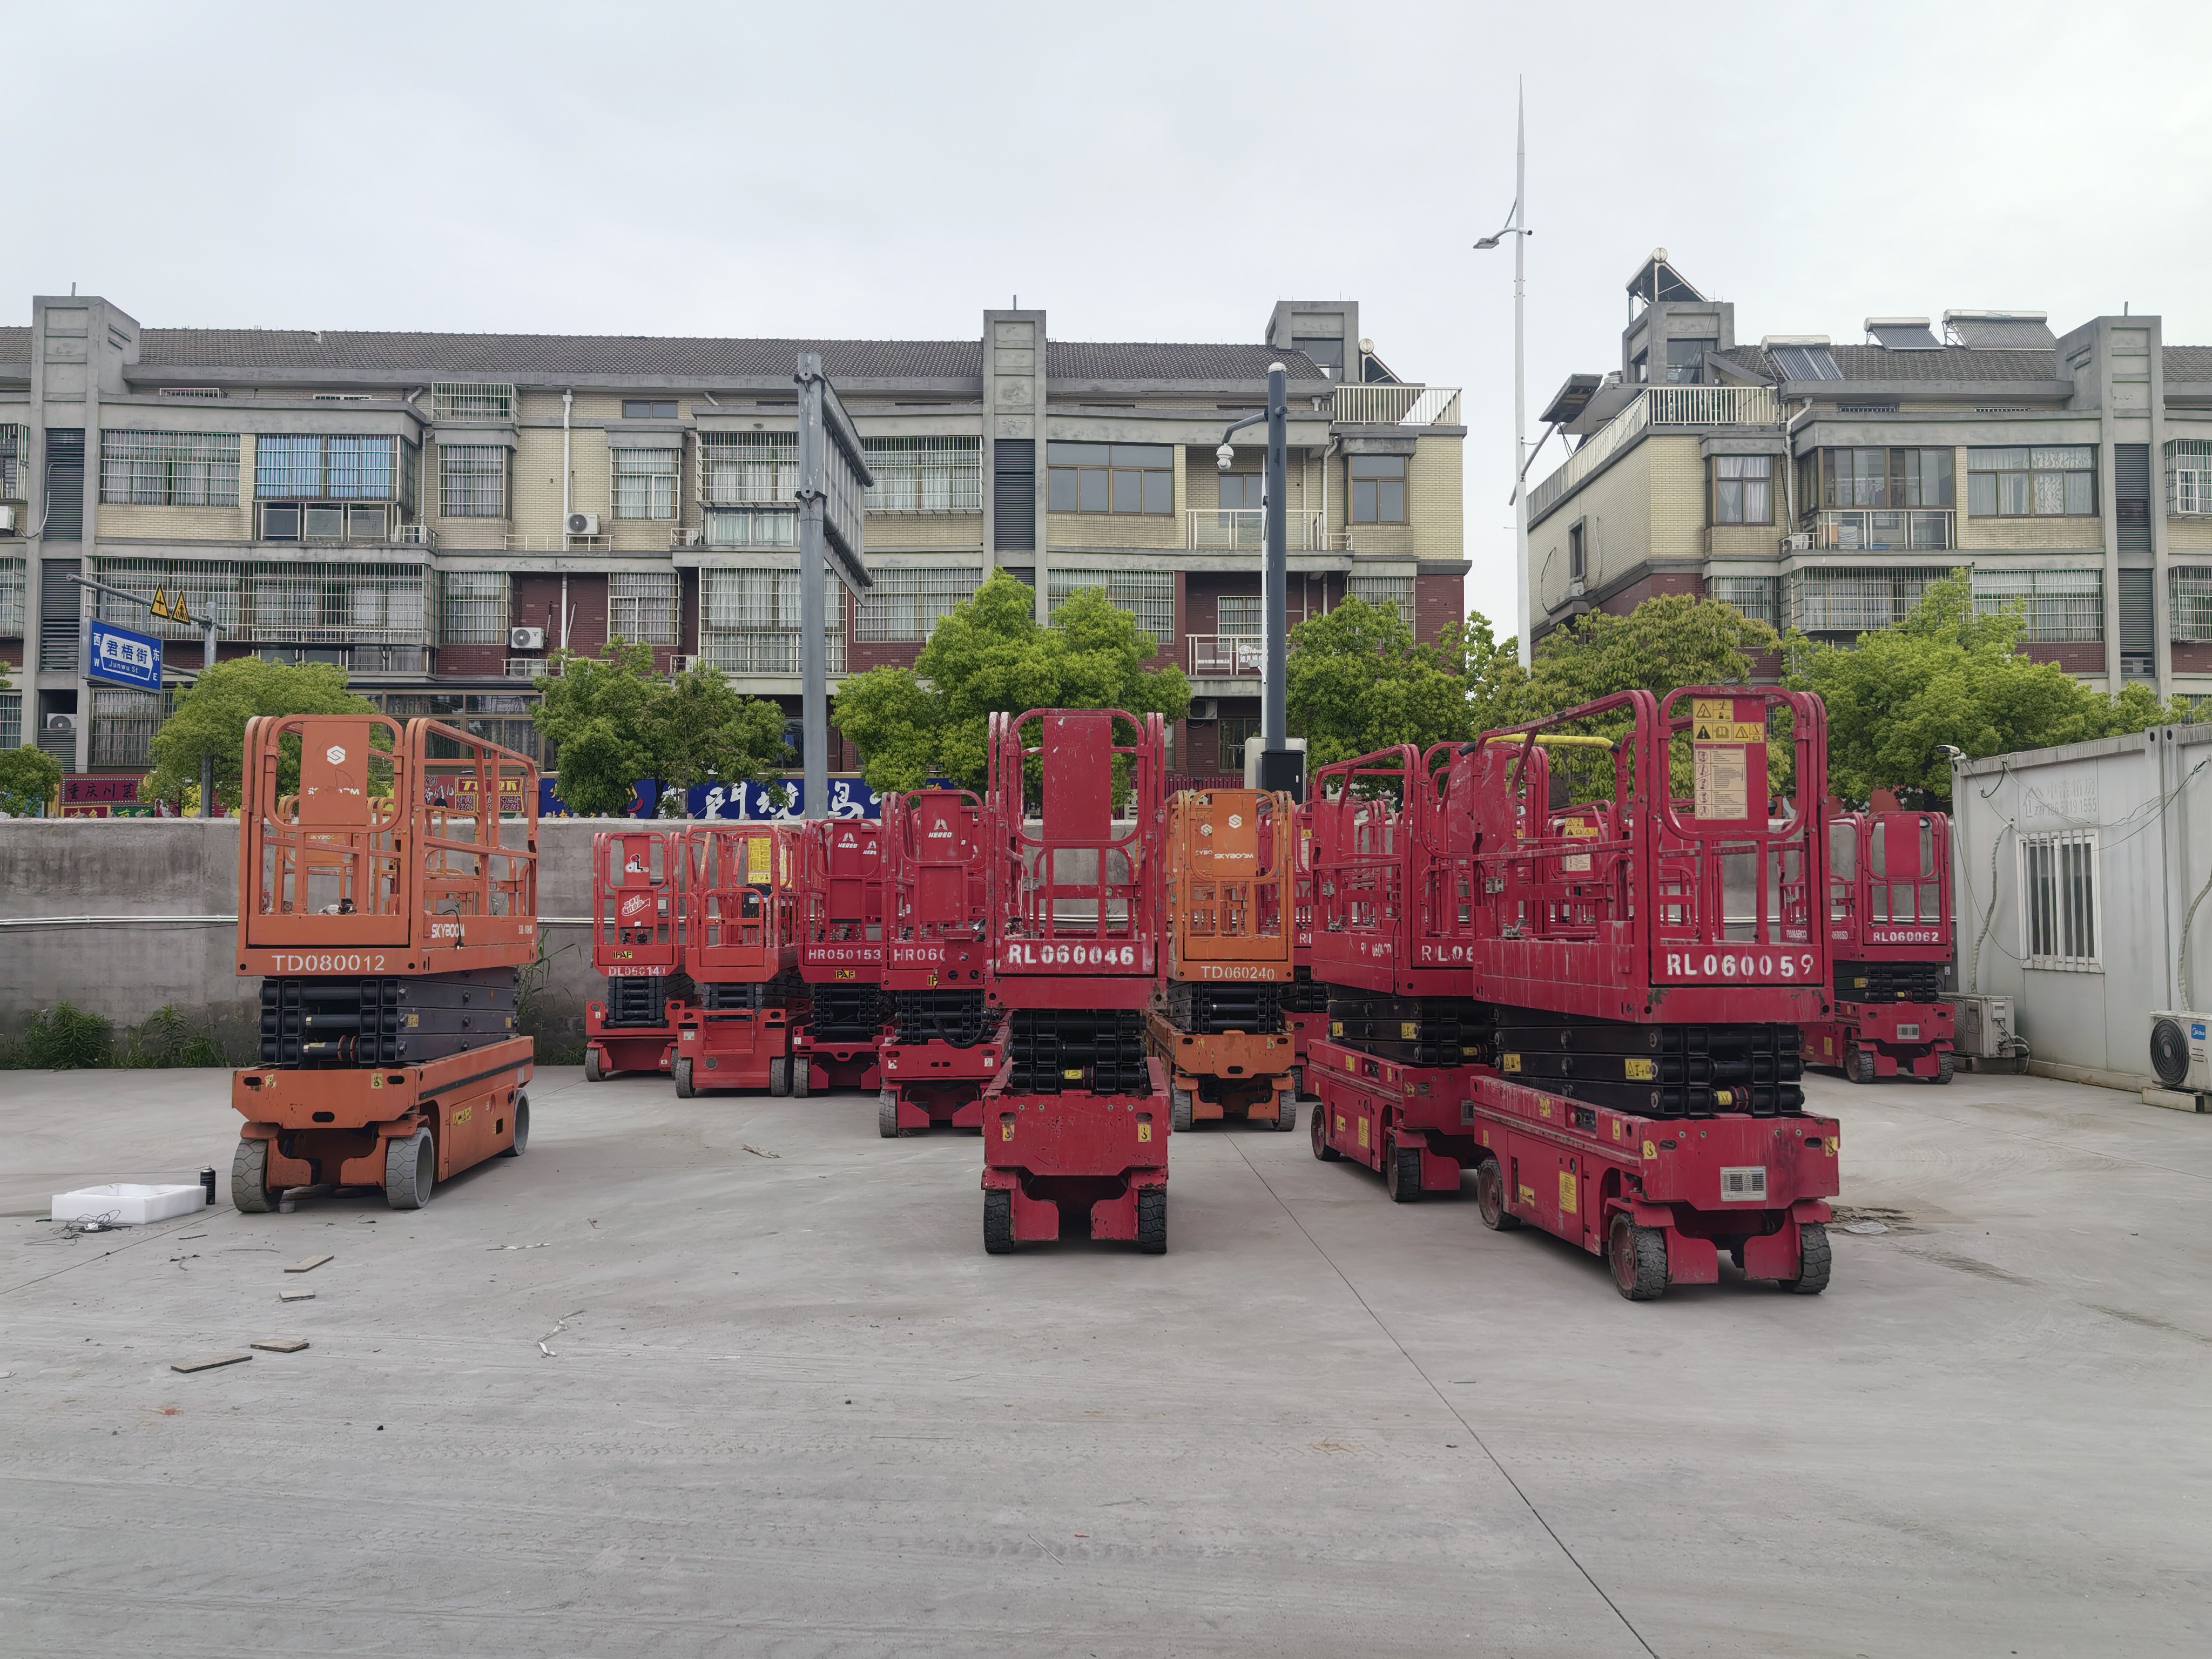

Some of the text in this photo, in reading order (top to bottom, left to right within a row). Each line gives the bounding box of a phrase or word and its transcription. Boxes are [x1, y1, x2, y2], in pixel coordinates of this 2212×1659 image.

[93, 632, 102, 646] 西
[106, 640, 147, 664] 君梧街
[153, 649, 160, 661] 东
[94, 658, 100, 667] W
[109, 660, 130, 671] Junwu
[68, 783, 134, 799] 重庆川菜
[1873, 932, 1939, 942] RL060062
[809, 949, 881, 960] HR050153
[1009, 945, 1134, 965] RL060046
[271, 954, 385, 972] TD080012
[1667, 953, 1814, 977] RL060059
[1201, 966, 1275, 980] TD060240
